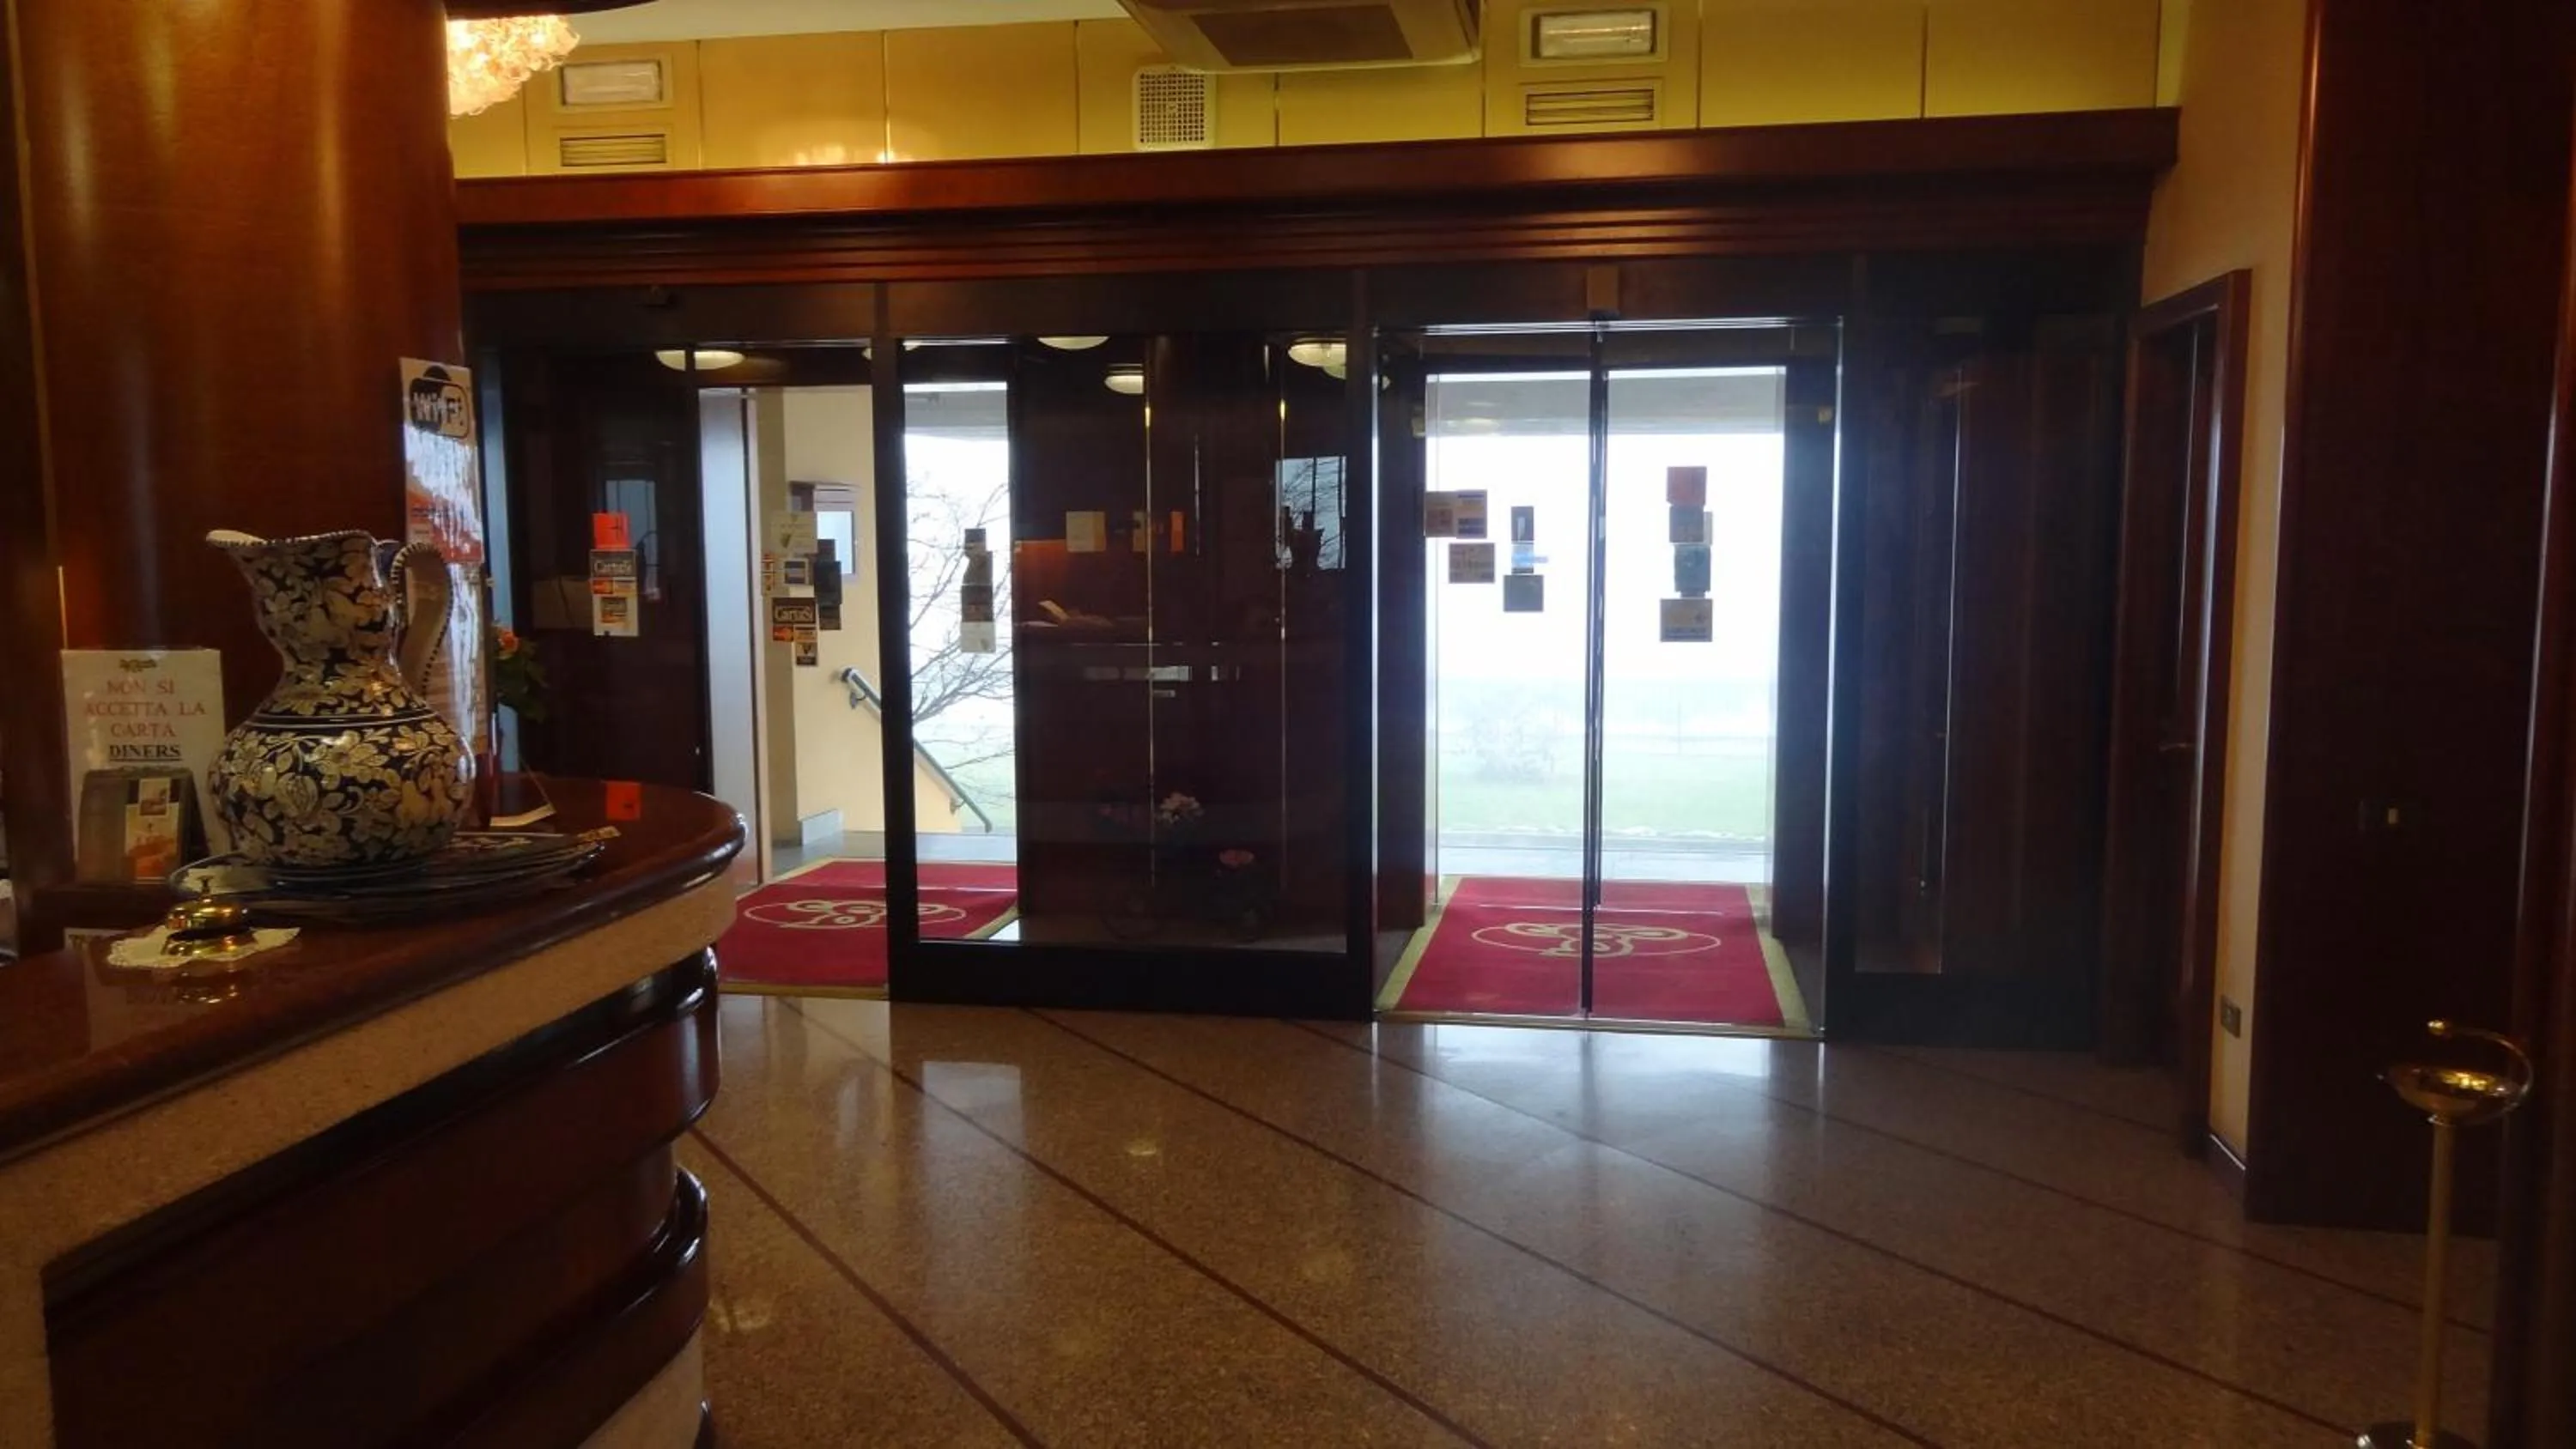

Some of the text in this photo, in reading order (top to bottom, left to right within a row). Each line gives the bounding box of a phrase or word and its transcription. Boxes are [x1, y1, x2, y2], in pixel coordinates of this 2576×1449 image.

[106, 679, 174, 695] NON SI
[84, 701, 206, 717] ACCETTA LA
[110, 723, 176, 737] CARTA
[109, 744, 182, 759] DINERS
